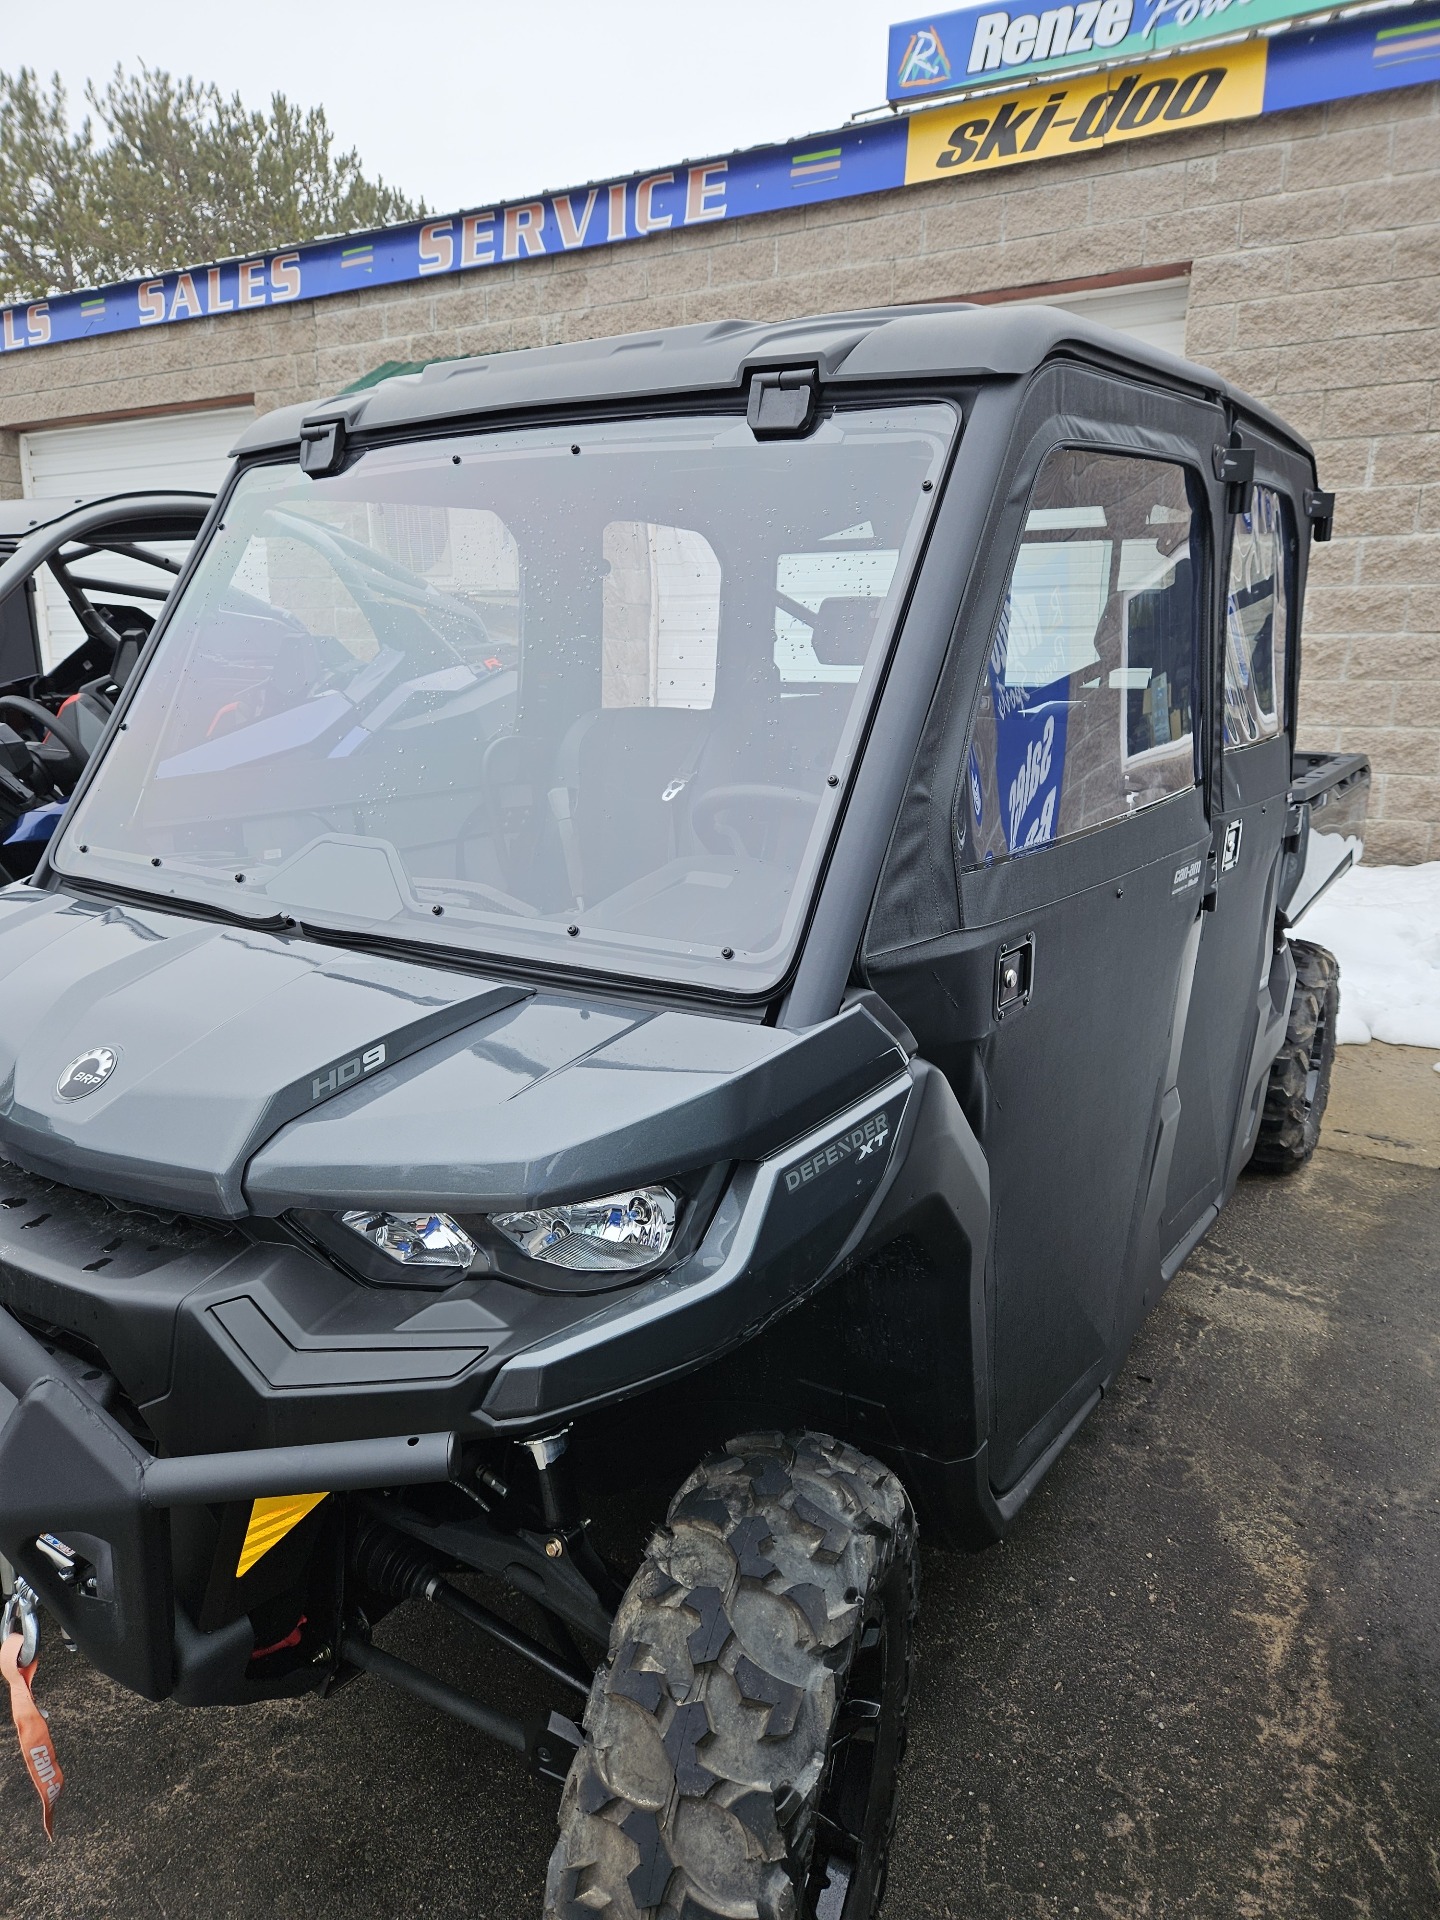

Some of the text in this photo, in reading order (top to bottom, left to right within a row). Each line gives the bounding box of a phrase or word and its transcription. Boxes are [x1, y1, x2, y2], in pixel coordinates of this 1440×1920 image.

[966, 0, 1250, 75] Renze Pow
[936, 67, 1228, 169] ski-doo
[137, 252, 302, 326] SALES
[418, 160, 731, 276] SERVICE
[1173, 860, 1202, 885] can-am
[72, 1071, 102, 1085] BRP
[312, 1043, 386, 1100] HD9
[785, 1112, 889, 1192] DEFENDER
[858, 1128, 889, 1161] XT
